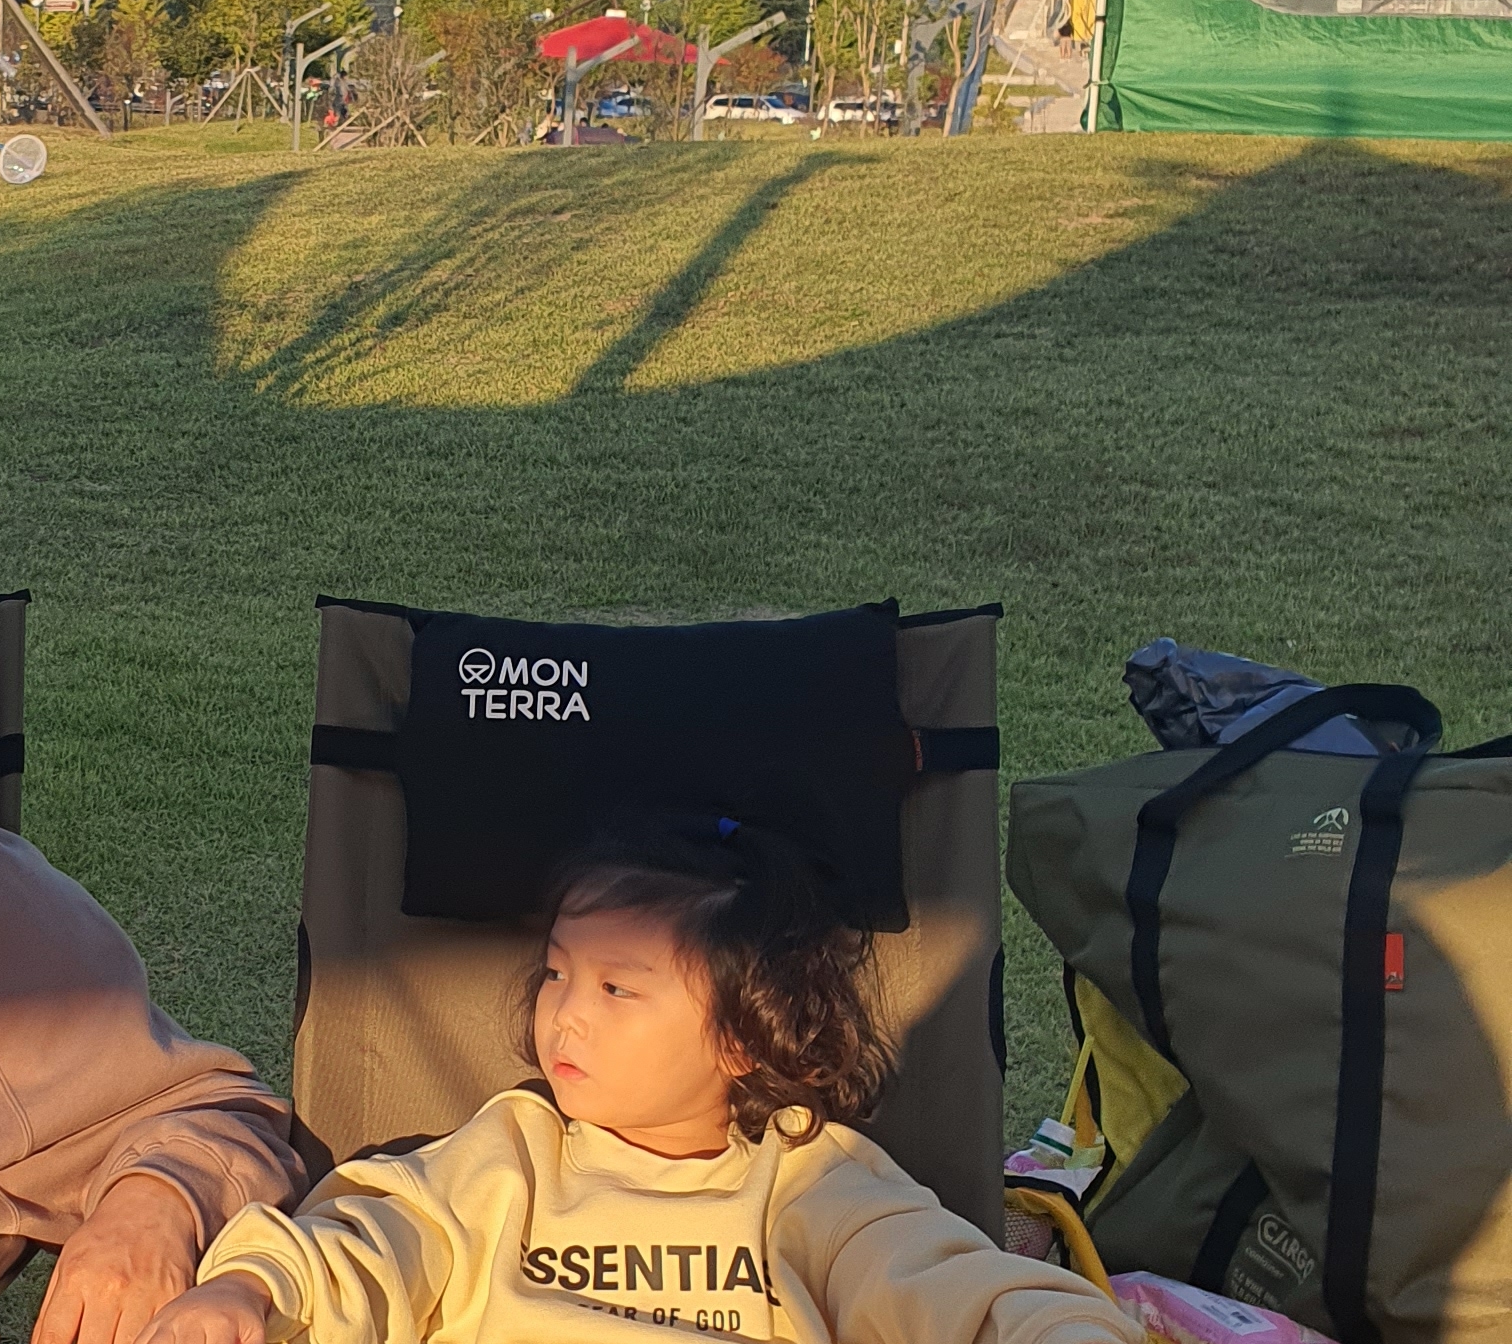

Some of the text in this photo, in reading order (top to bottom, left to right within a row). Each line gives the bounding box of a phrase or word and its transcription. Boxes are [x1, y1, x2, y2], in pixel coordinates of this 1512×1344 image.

[498, 656, 588, 687] MON
[461, 688, 591, 721] TERRA
[520, 1244, 775, 1301] SSENTIA
[652, 1307, 682, 1327] OF
[695, 1308, 742, 1332] GOD
